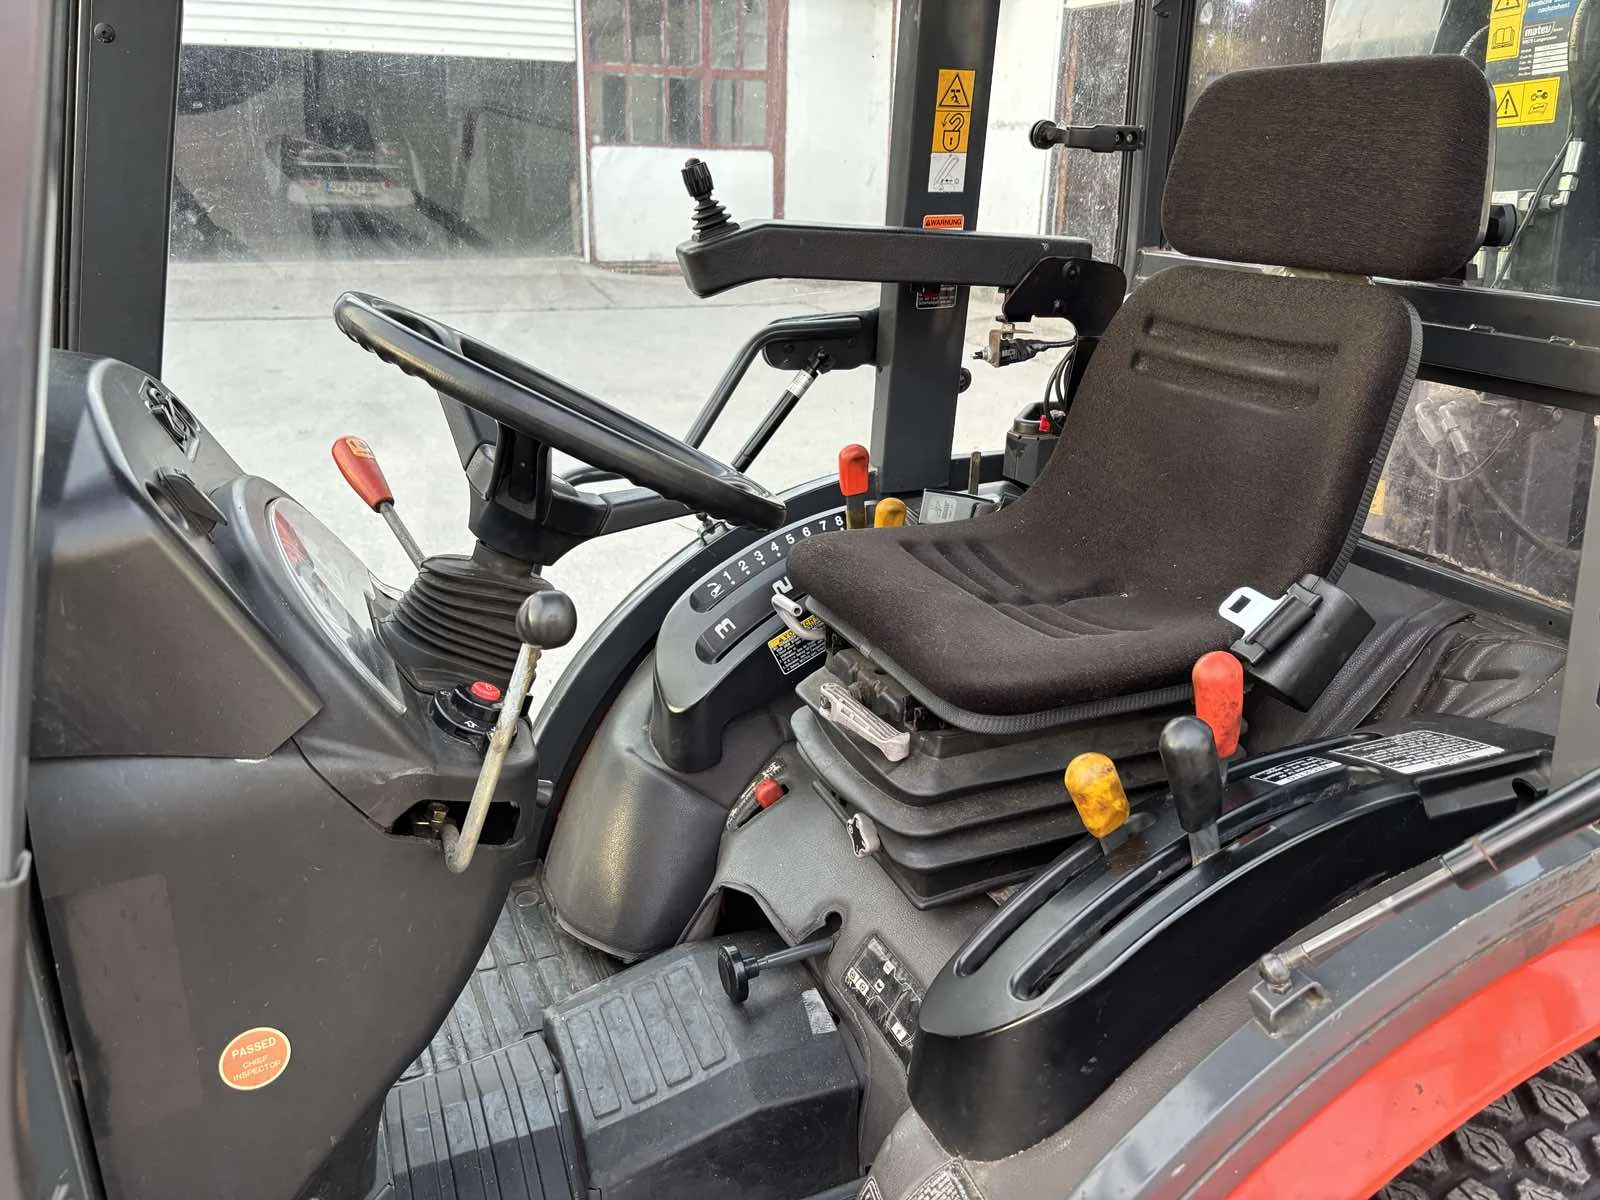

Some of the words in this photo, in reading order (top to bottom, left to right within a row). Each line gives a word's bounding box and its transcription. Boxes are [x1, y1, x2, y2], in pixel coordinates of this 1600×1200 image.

[1524, 25, 1552, 37] matev
[931, 218, 962, 226] WARNUNG
[722, 570, 732, 580] 1
[738, 560, 749, 571] 2
[754, 550, 764, 561] 3
[771, 541, 779, 552] 4
[785, 533, 795, 544] 5
[802, 526, 812, 537] 6
[819, 520, 827, 531] 7
[834, 515, 844, 526] 8
[231, 1036, 277, 1061] PASSED
[233, 1060, 282, 1081] INSPECTOR
[242, 1054, 269, 1069] CHIEF
